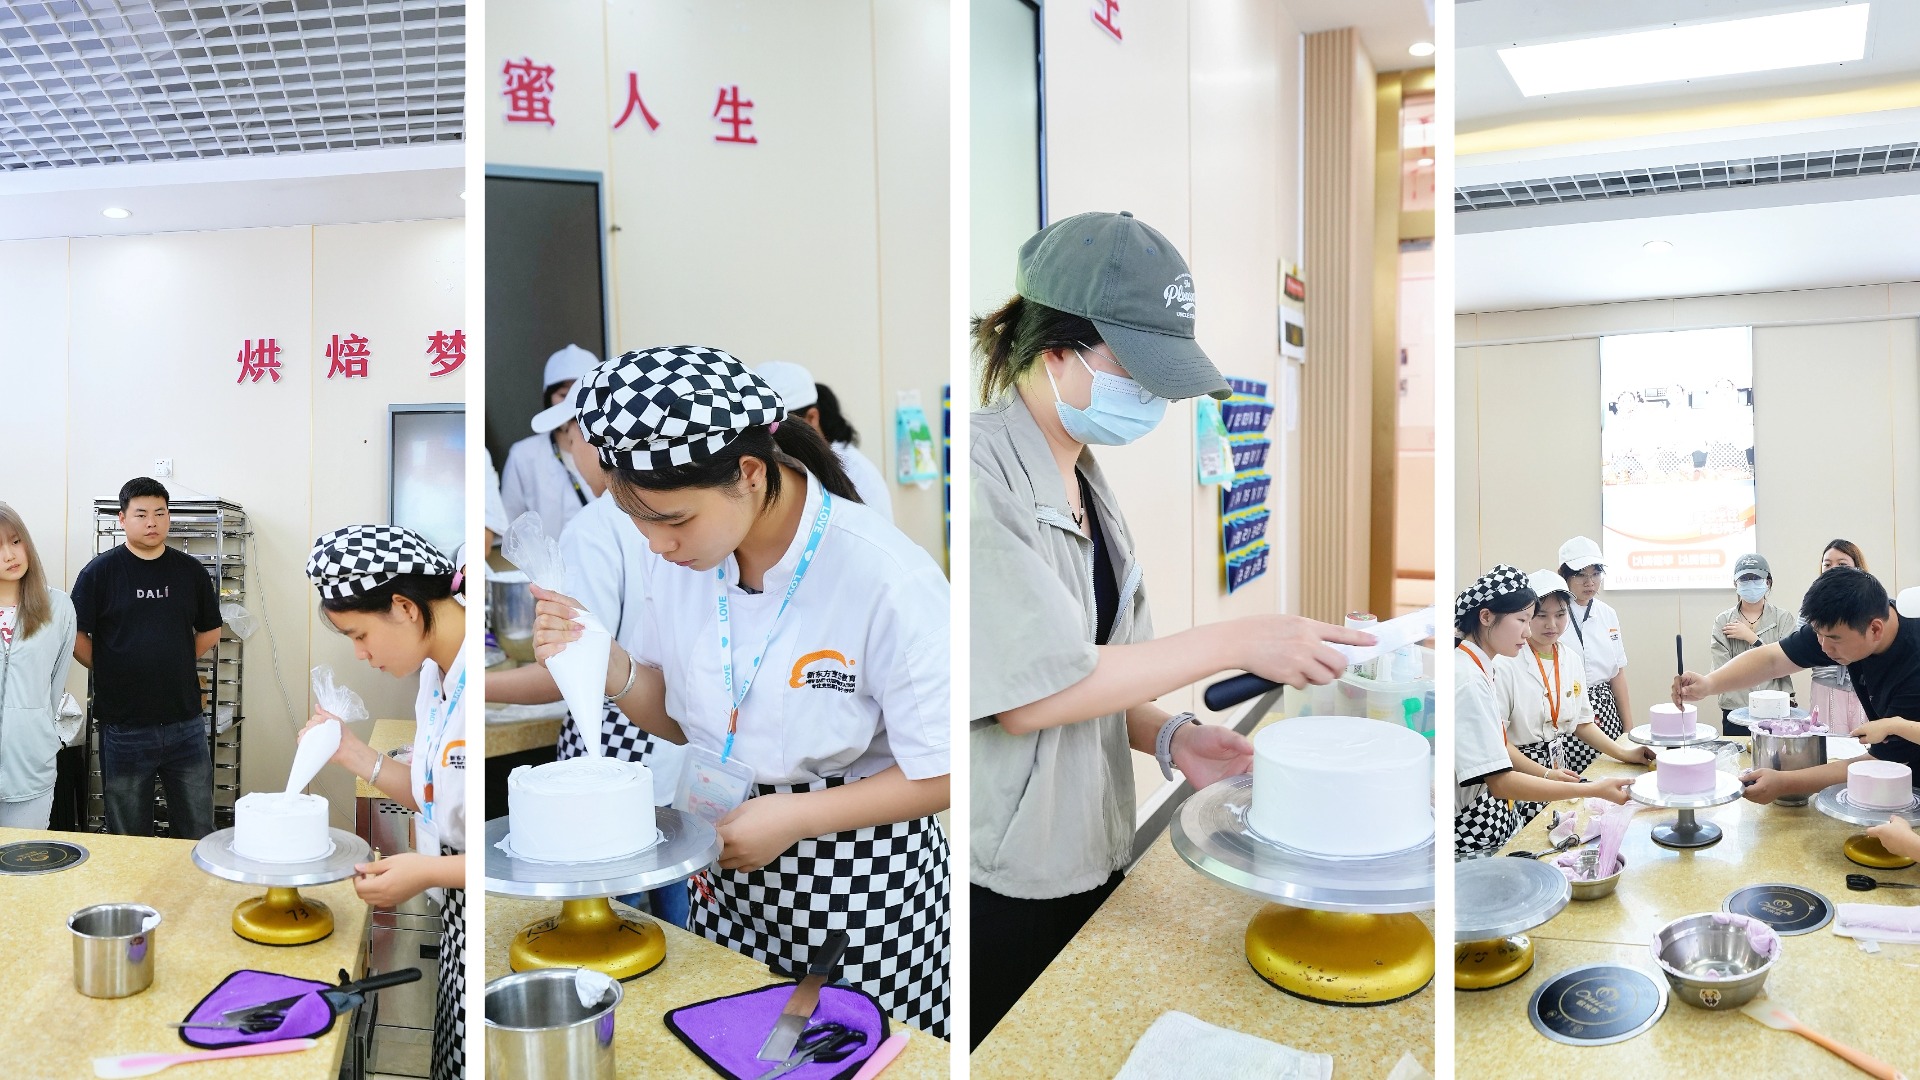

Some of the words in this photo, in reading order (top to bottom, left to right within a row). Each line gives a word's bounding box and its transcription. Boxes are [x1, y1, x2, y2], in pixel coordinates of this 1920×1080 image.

[502, 57, 759, 145] 蜜人生
[236, 329, 466, 385] 烘焙梦
[814, 506, 830, 534] LOVE
[136, 586, 169, 599] DALÍ
[786, 574, 802, 600] LOV
[719, 595, 728, 622] LOVE
[724, 664, 732, 692] LOVE
[429, 707, 437, 726] LOVE
